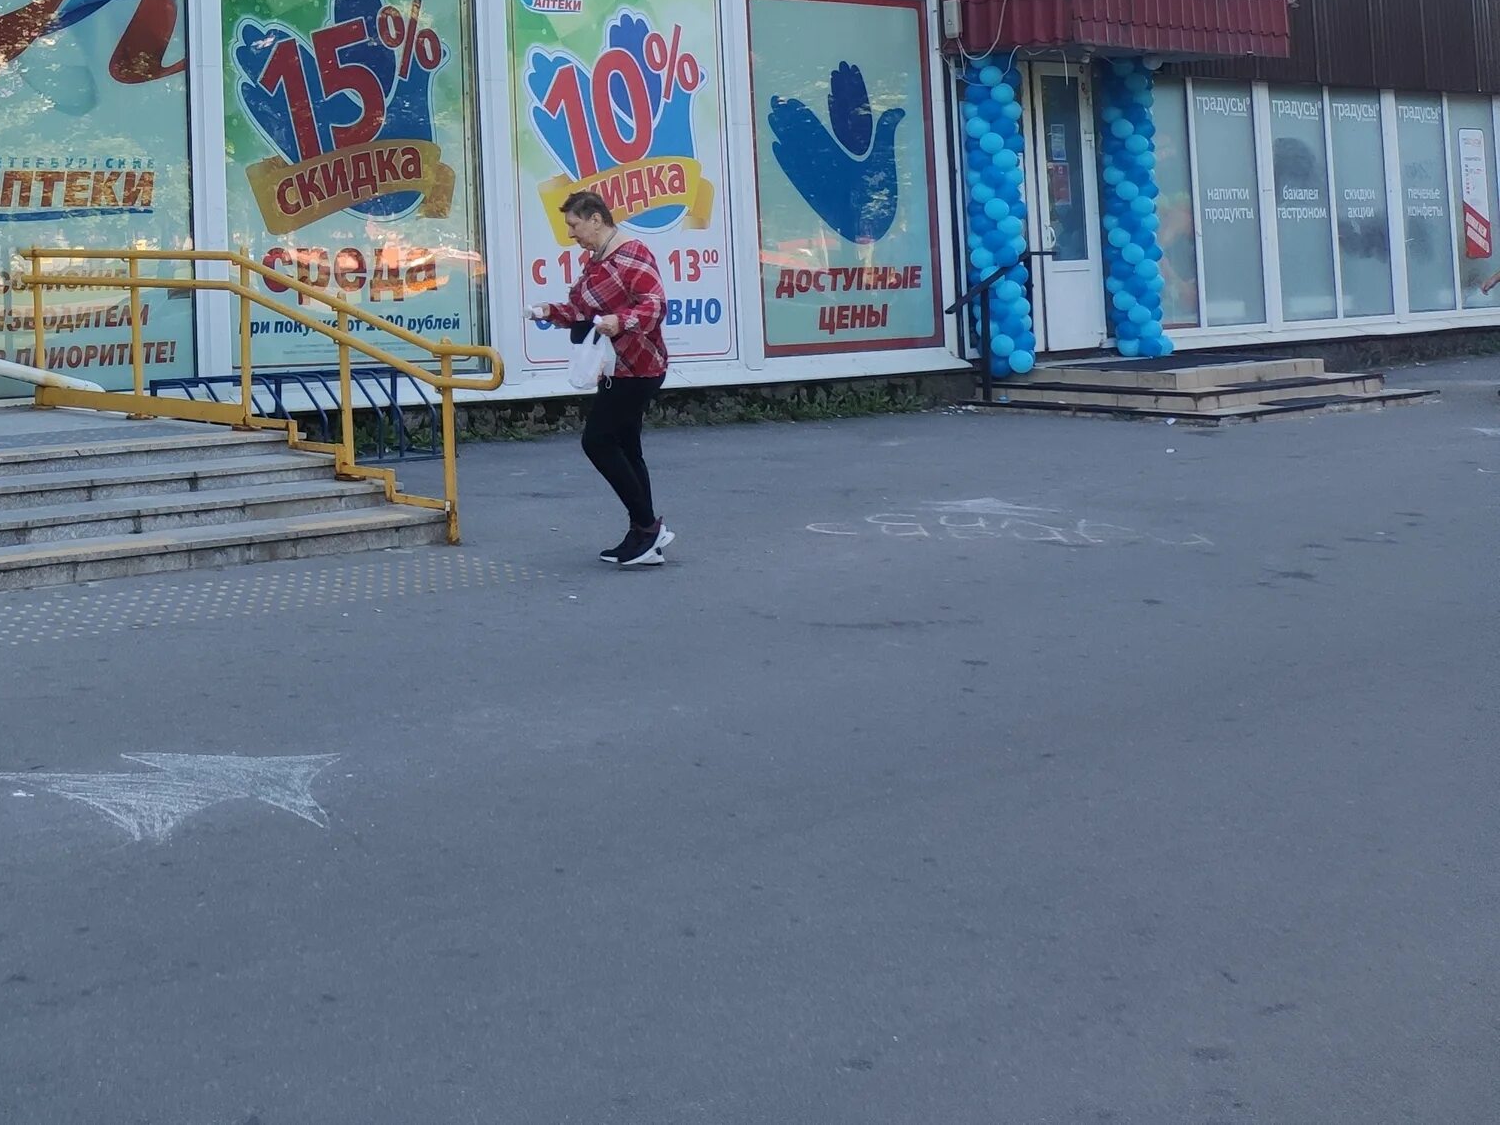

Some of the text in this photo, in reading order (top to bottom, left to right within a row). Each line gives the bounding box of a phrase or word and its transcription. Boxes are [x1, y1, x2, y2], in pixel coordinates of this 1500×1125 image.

[543, 24, 699, 178] 10%
[276, 146, 422, 215] скидка
[1207, 188, 1250, 201] напитки
[1283, 185, 1319, 200] бакалея
[1344, 188, 1376, 202] скидки
[1408, 188, 1441, 200] печенье
[1205, 207, 1255, 223] продукты
[1277, 207, 1328, 223] гастроном
[1347, 206, 1375, 219] акции
[1407, 203, 1444, 220] конфеты
[262, 247, 438, 305] среда
[776, 266, 922, 299] ДОСТУПНЫЕ
[408, 313, 460, 334] рублей
[818, 303, 888, 335] ЦЕНЫ
